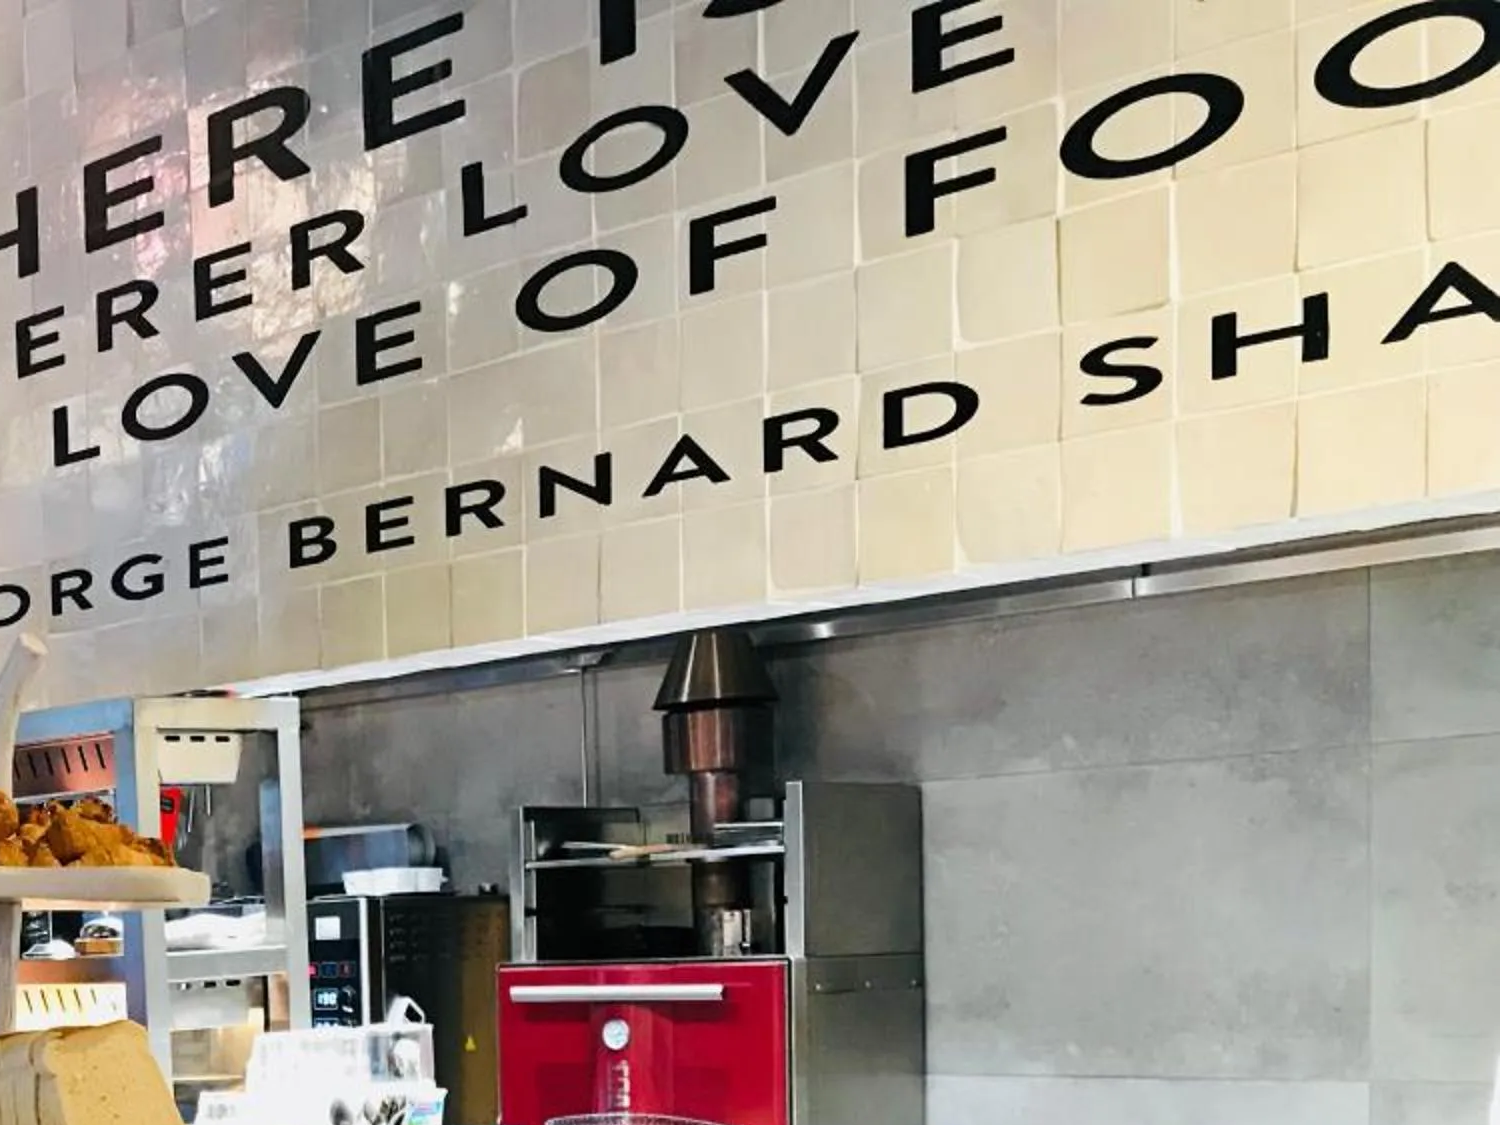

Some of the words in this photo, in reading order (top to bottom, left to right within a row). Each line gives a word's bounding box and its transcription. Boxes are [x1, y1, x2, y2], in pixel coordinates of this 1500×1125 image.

[52, 301, 423, 467] LOVE
[515, 196, 777, 333] OF
[905, 0, 1500, 238] FOO
[461, 0, 1015, 237] LOVE
[288, 381, 979, 569] BERNARD
[1079, 261, 1500, 405] SHA
